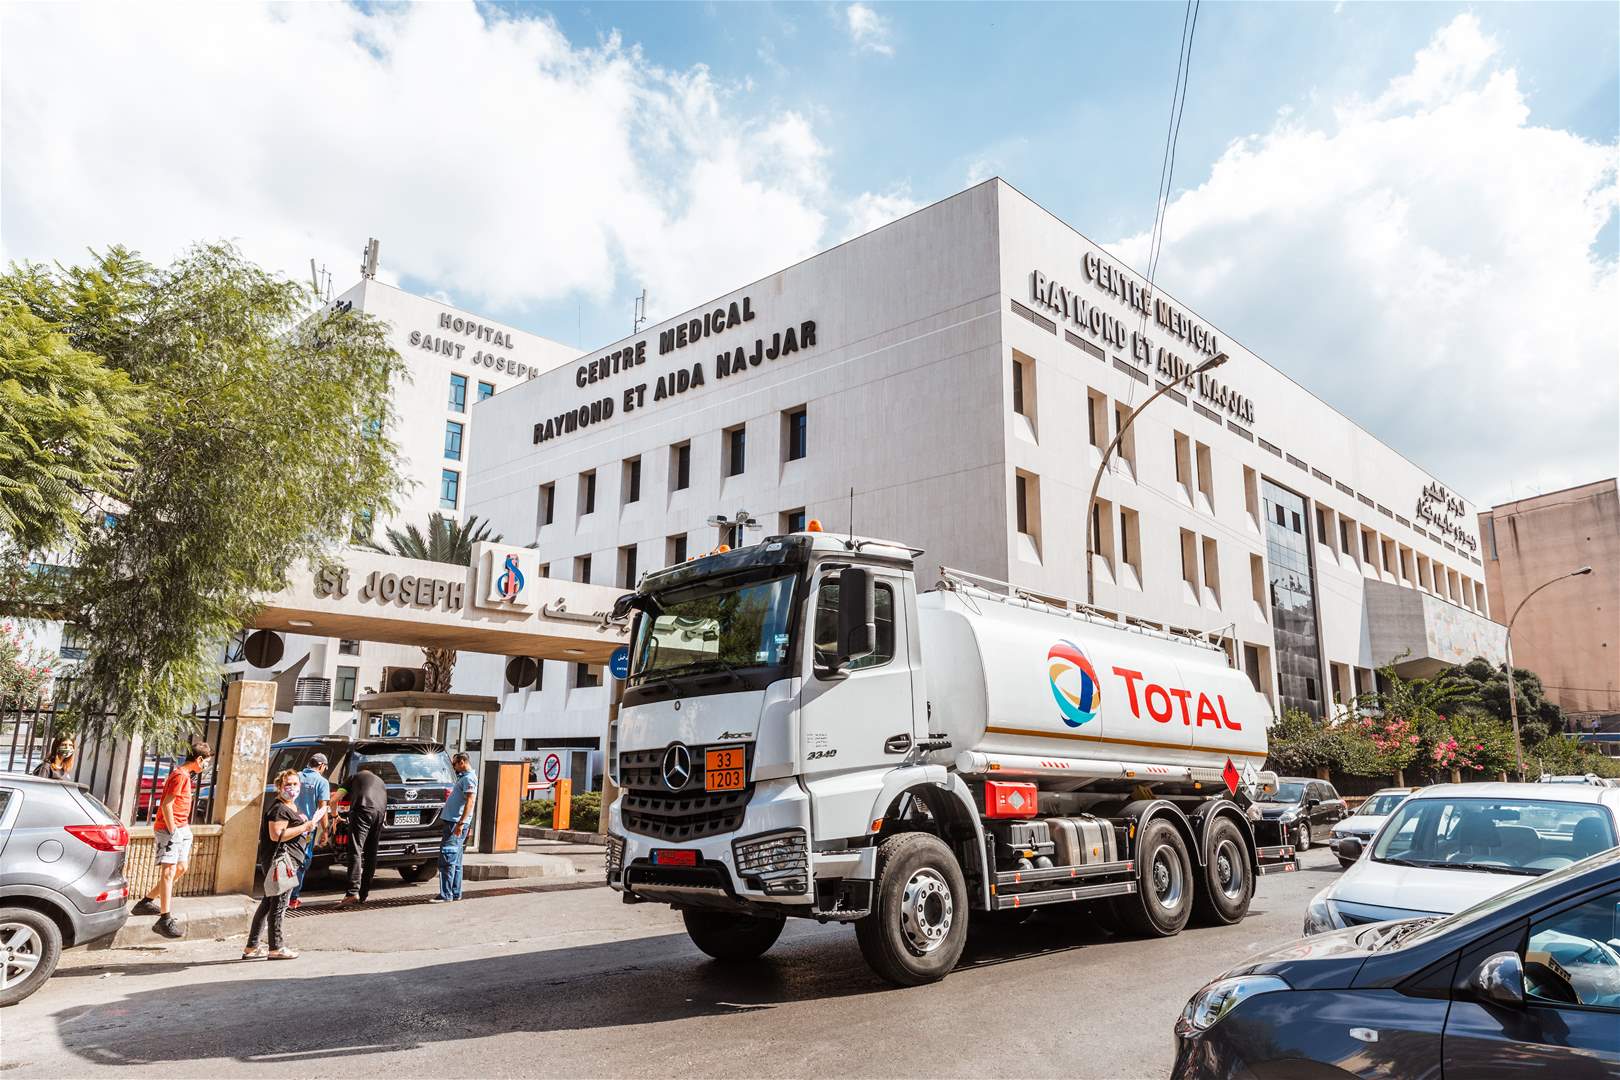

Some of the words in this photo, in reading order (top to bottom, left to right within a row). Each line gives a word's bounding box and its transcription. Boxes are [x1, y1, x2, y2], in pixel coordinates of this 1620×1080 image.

[439, 312, 514, 350] HOPITAL
[1084, 251, 1153, 316] CENTRE
[1155, 298, 1218, 356] MEDICAL
[409, 330, 465, 359] SAINT
[472, 350, 539, 380] JOSEPH
[576, 340, 647, 388] CENTRE
[659, 296, 755, 356] MEDICAL
[1032, 269, 1128, 350] RAYMOND
[1132, 331, 1153, 365] ET
[1157, 347, 1196, 389] AIDA
[1199, 372, 1255, 423] NAJJAR
[533, 397, 615, 445] RAYMOND
[623, 383, 647, 412] ET
[653, 362, 705, 402] AIDA
[716, 320, 817, 379] NAJJAR
[317, 565, 350, 597] St
[363, 571, 466, 612] JOSEPH
[1111, 666, 1243, 731] TOTAL
[710, 771, 740, 788] 1203
[716, 752, 732, 768] 33
